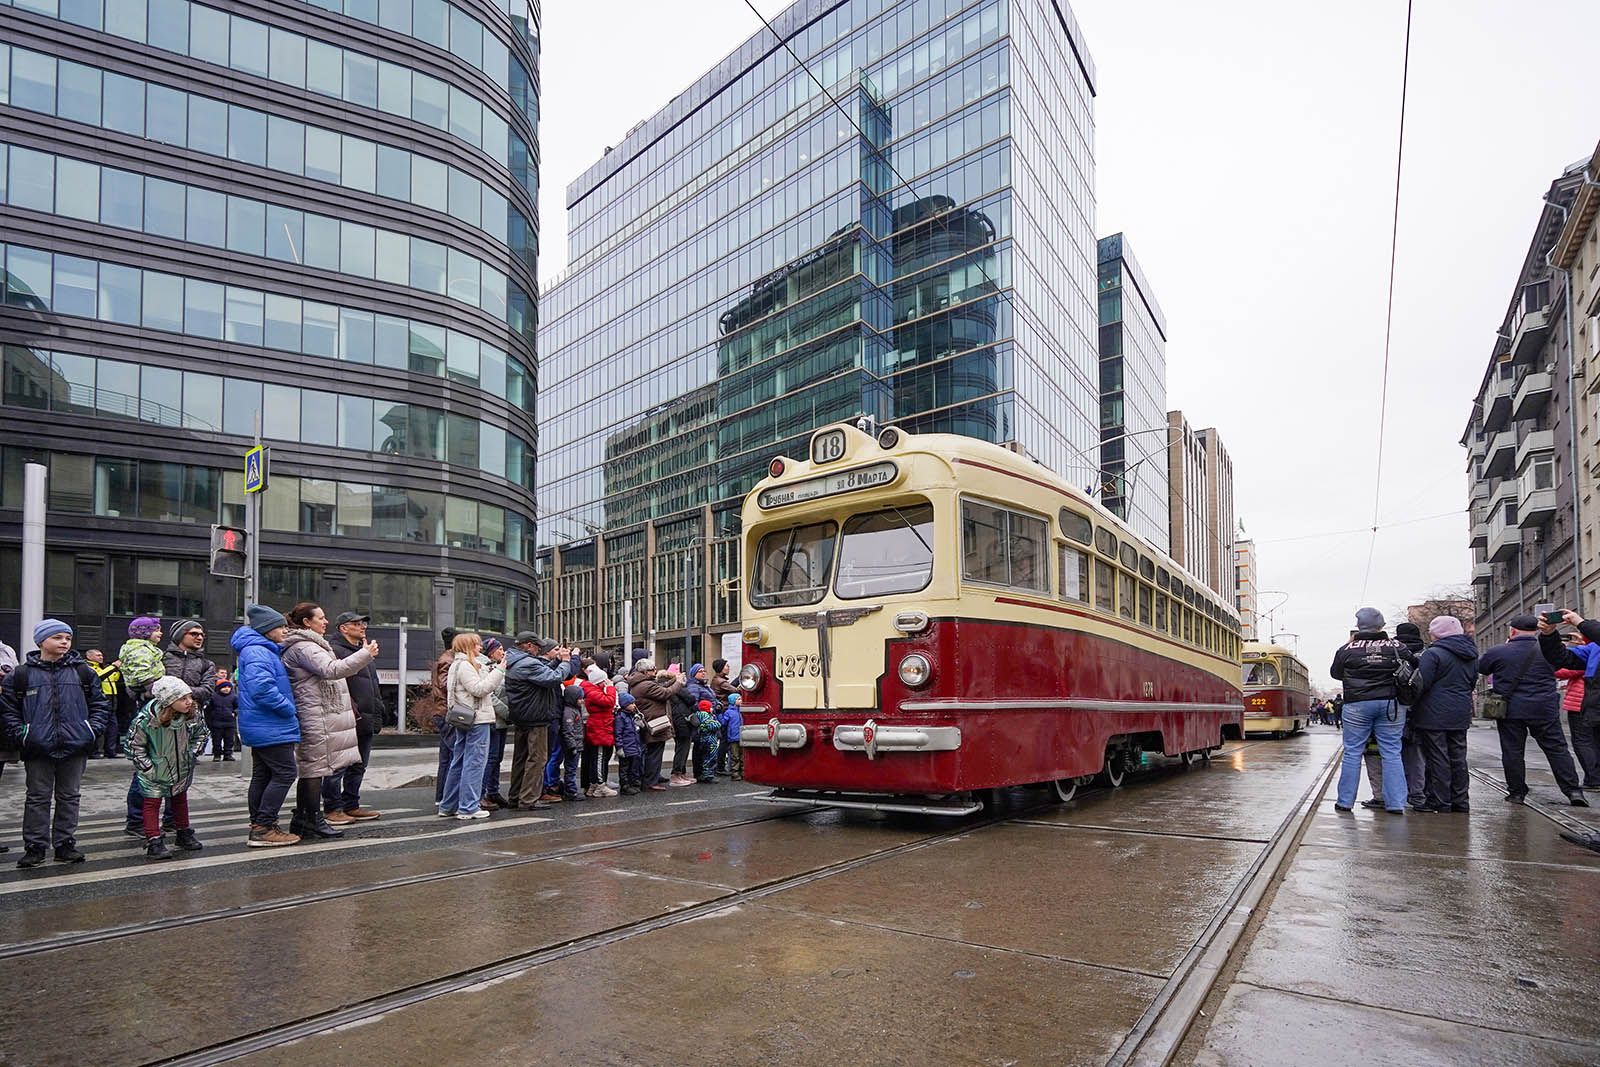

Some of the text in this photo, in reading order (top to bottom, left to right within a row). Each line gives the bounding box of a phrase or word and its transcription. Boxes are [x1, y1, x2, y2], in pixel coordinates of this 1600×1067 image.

[821, 436, 840, 460] 18
[847, 472, 856, 488] 8
[777, 654, 821, 678] 1278
